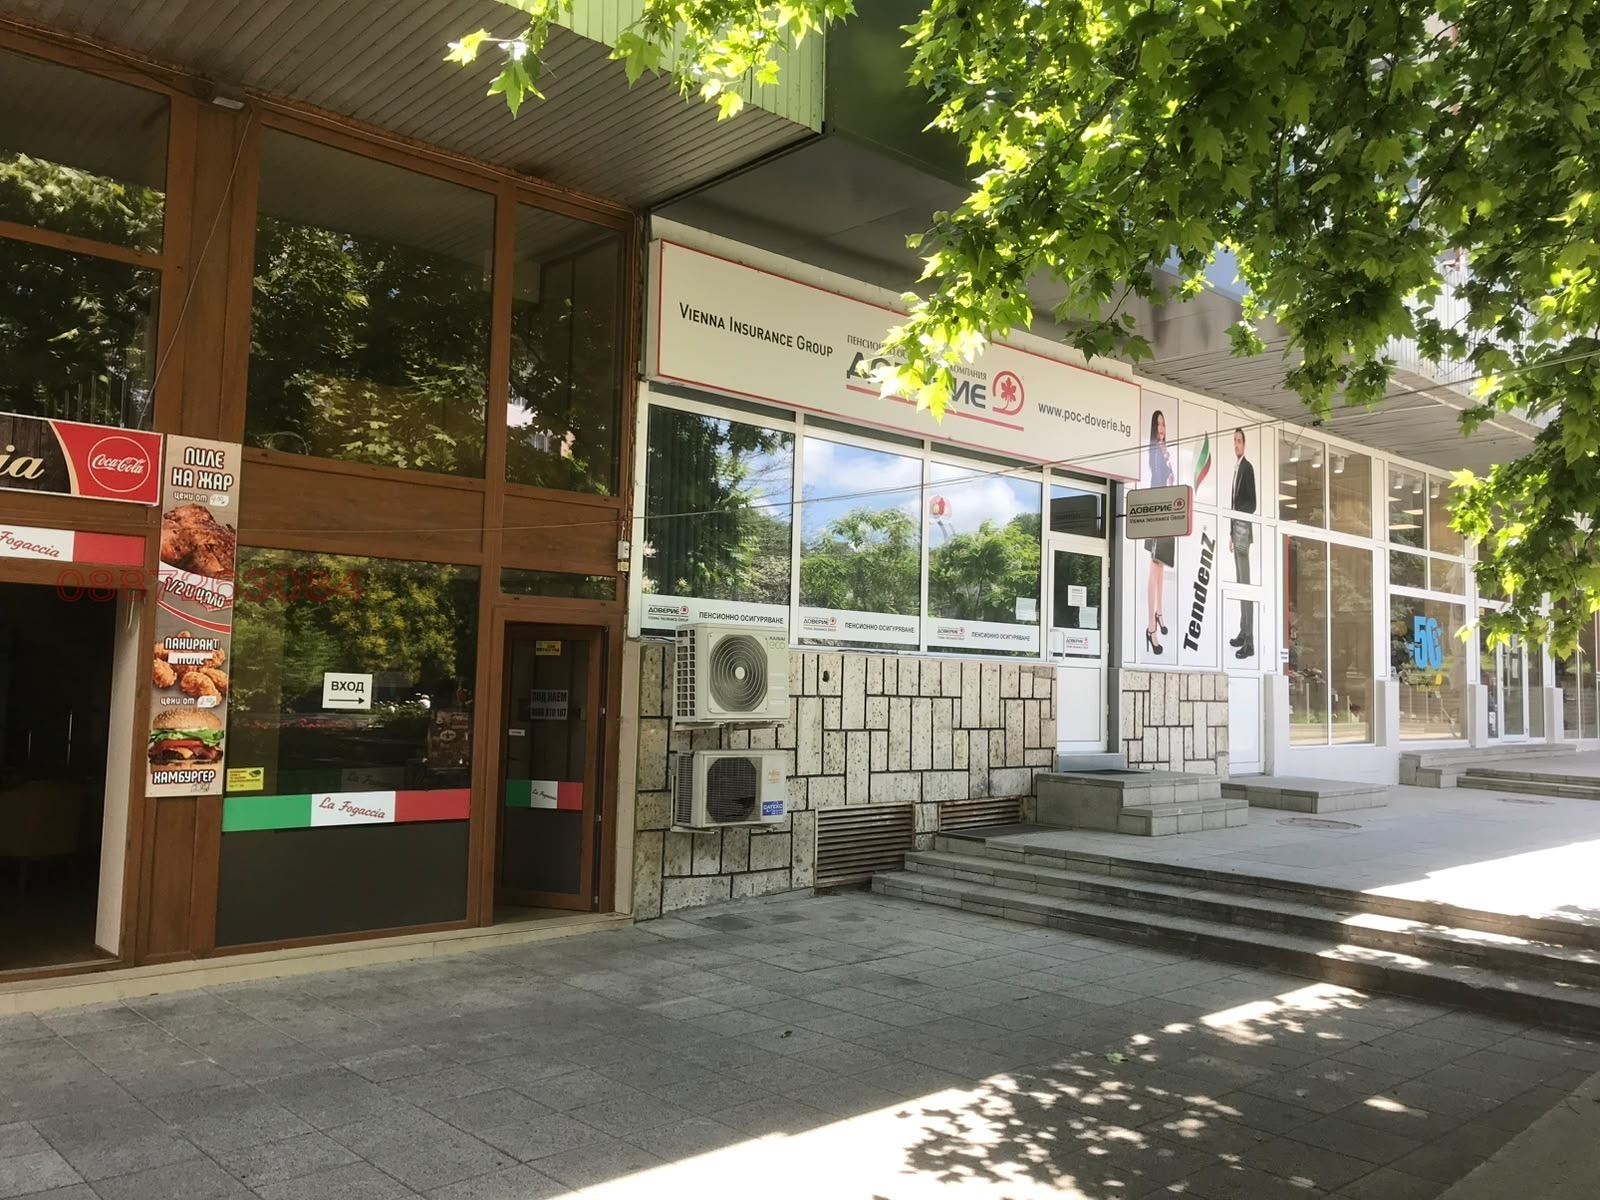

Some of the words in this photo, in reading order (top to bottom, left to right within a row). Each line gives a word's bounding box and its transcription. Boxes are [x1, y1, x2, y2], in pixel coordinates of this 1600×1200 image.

[1037, 402, 1131, 438] www.poc-doverie.bg
[91, 453, 147, 475] Coca-Cola
[184, 446, 225, 470] ПИЛЕ
[172, 467, 194, 488] НА
[197, 471, 234, 492] ЖАР
[1130, 503, 1173, 515] ДОВЕРИЕ
[165, 577, 185, 596] 1/2
[1183, 532, 1216, 652] Tendenz
[647, 606, 680, 615] ДОВЕРИЕ
[699, 611, 739, 621] ПЕНСИОННО
[740, 614, 784, 625] ОСИГУРЯВАНЕ
[844, 622, 878, 631] ПЕНСИОННО
[878, 623, 915, 633] ОСИГУРЯВАНЕ
[971, 631, 1000, 639] ПЕНСИОННО
[1000, 633, 1031, 642] ОСИГУРЯВАНЕ
[331, 680, 365, 693] ВХОД
[153, 770, 215, 784] ХАМБУРГЕР
[319, 796, 336, 810] La
[338, 800, 386, 819] Fogaccia
